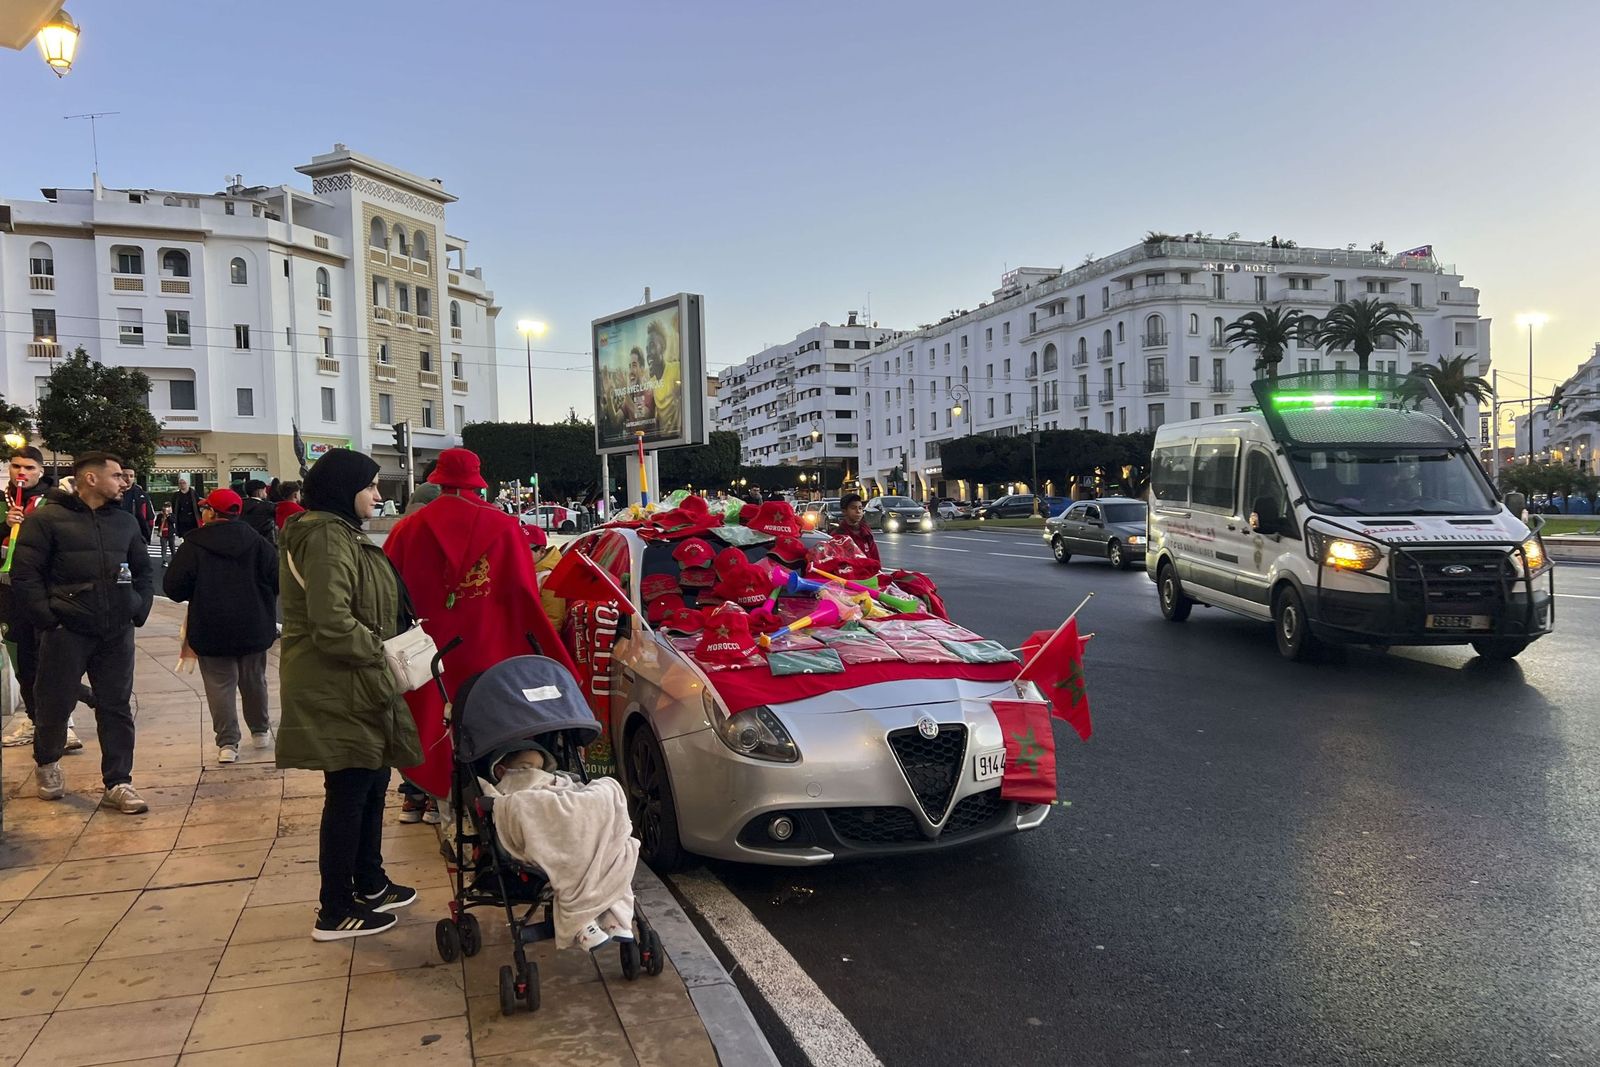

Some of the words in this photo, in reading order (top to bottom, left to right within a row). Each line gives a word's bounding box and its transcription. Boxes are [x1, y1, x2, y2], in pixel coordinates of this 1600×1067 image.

[1244, 264, 1277, 272] HOTEL
[738, 594, 766, 603] MOROCCO
[707, 643, 741, 652] MOROCCO
